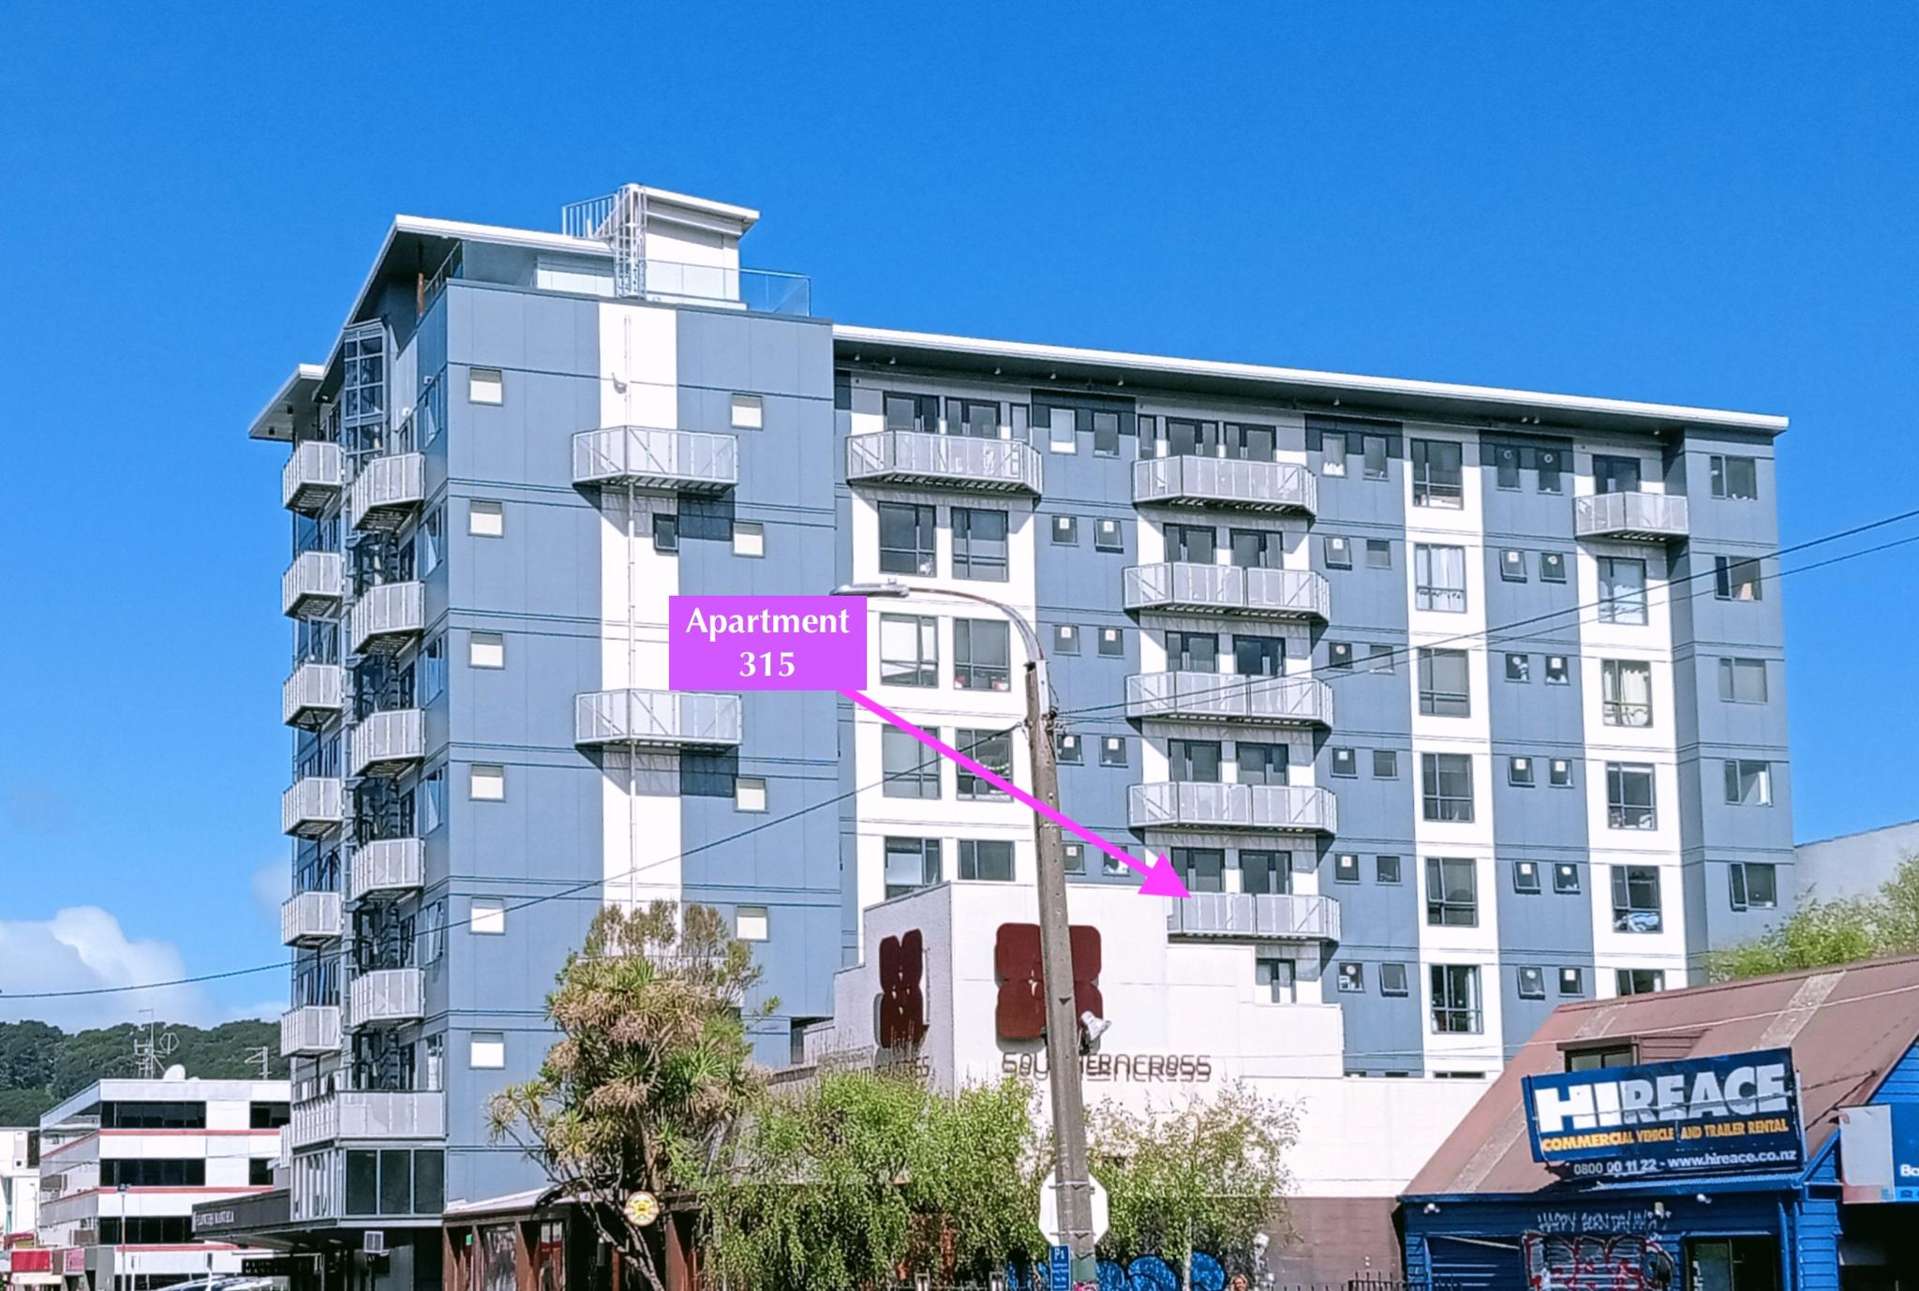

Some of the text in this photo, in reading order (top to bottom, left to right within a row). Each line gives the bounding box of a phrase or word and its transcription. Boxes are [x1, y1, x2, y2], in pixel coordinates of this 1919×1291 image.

[1002, 1052, 1212, 1081] SOUERNCROSS
[1535, 1063, 1788, 1133] HIREACE
[1543, 1118, 1789, 1152] COMMERCIAL VEHICLE AND TRAILER RENTAL
[1573, 1162, 1604, 1176] 0800
[1606, 1161, 1623, 1174] 00
[1625, 1159, 1637, 1171] 11
[1639, 1158, 1657, 1170] 22
[1667, 1150, 1797, 1168] www.hireace.co.nz
